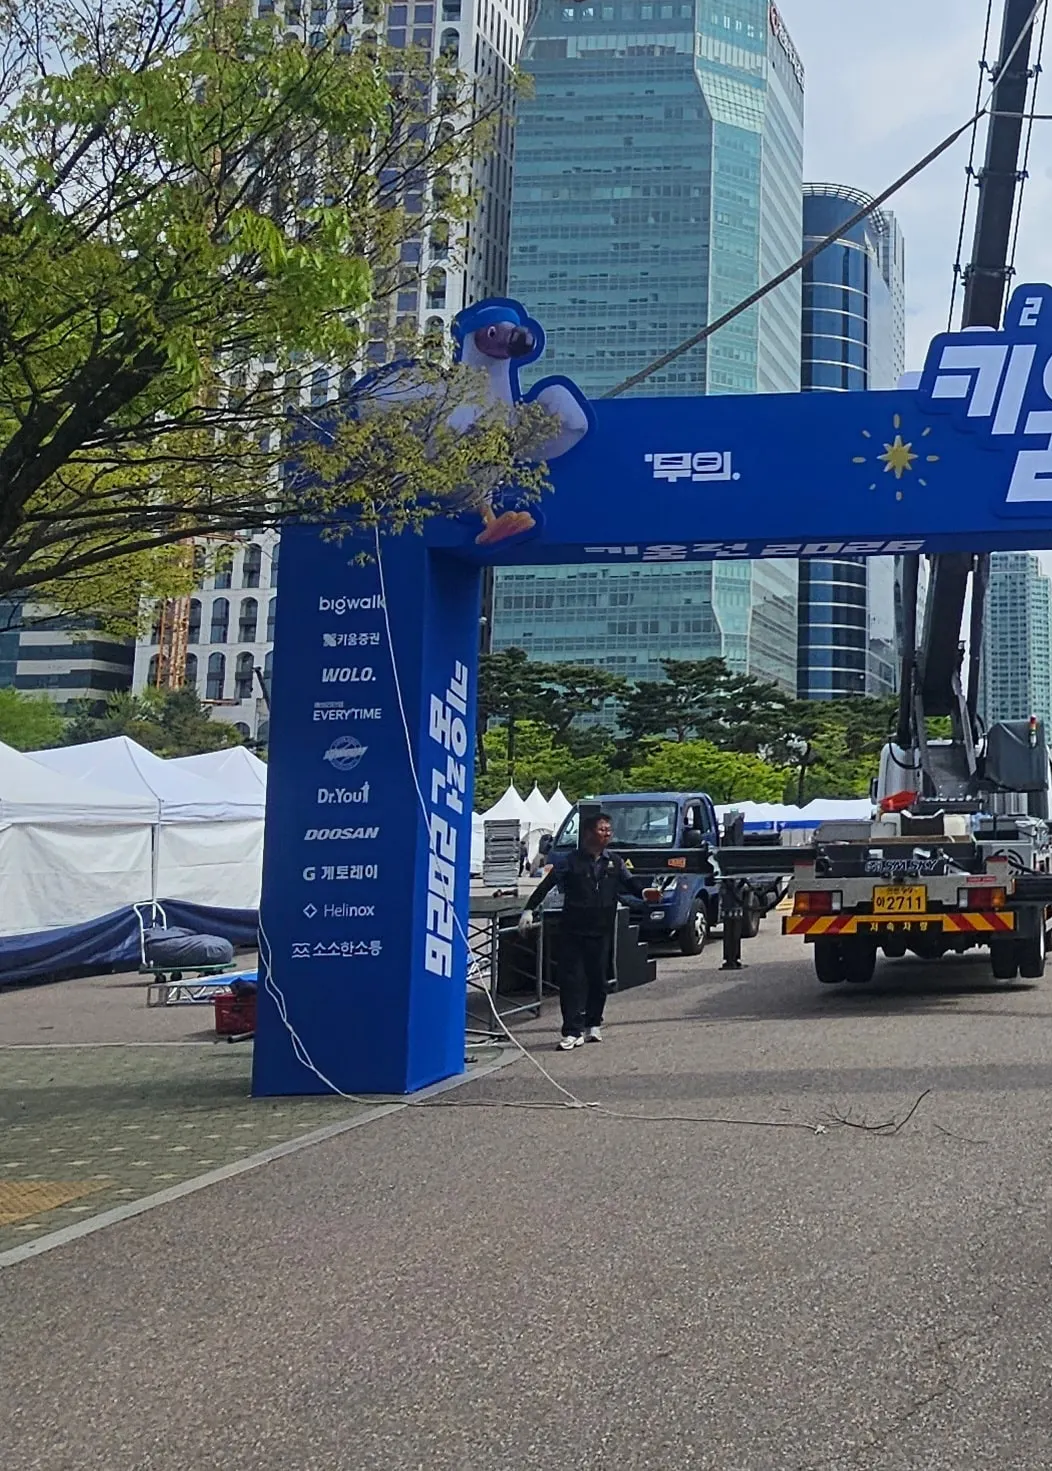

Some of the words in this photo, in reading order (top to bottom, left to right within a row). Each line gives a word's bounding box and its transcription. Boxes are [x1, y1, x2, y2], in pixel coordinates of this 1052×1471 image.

[760, 539, 926, 556] 2026
[318, 594, 387, 615] bigwalk
[321, 666, 377, 683] WOLO.
[303, 827, 380, 841] DOOSAN
[320, 864, 378, 880] 게토레이
[425, 816, 457, 978] 2026
[887, 895, 921, 910] 2711
[323, 903, 375, 918] Helinox
